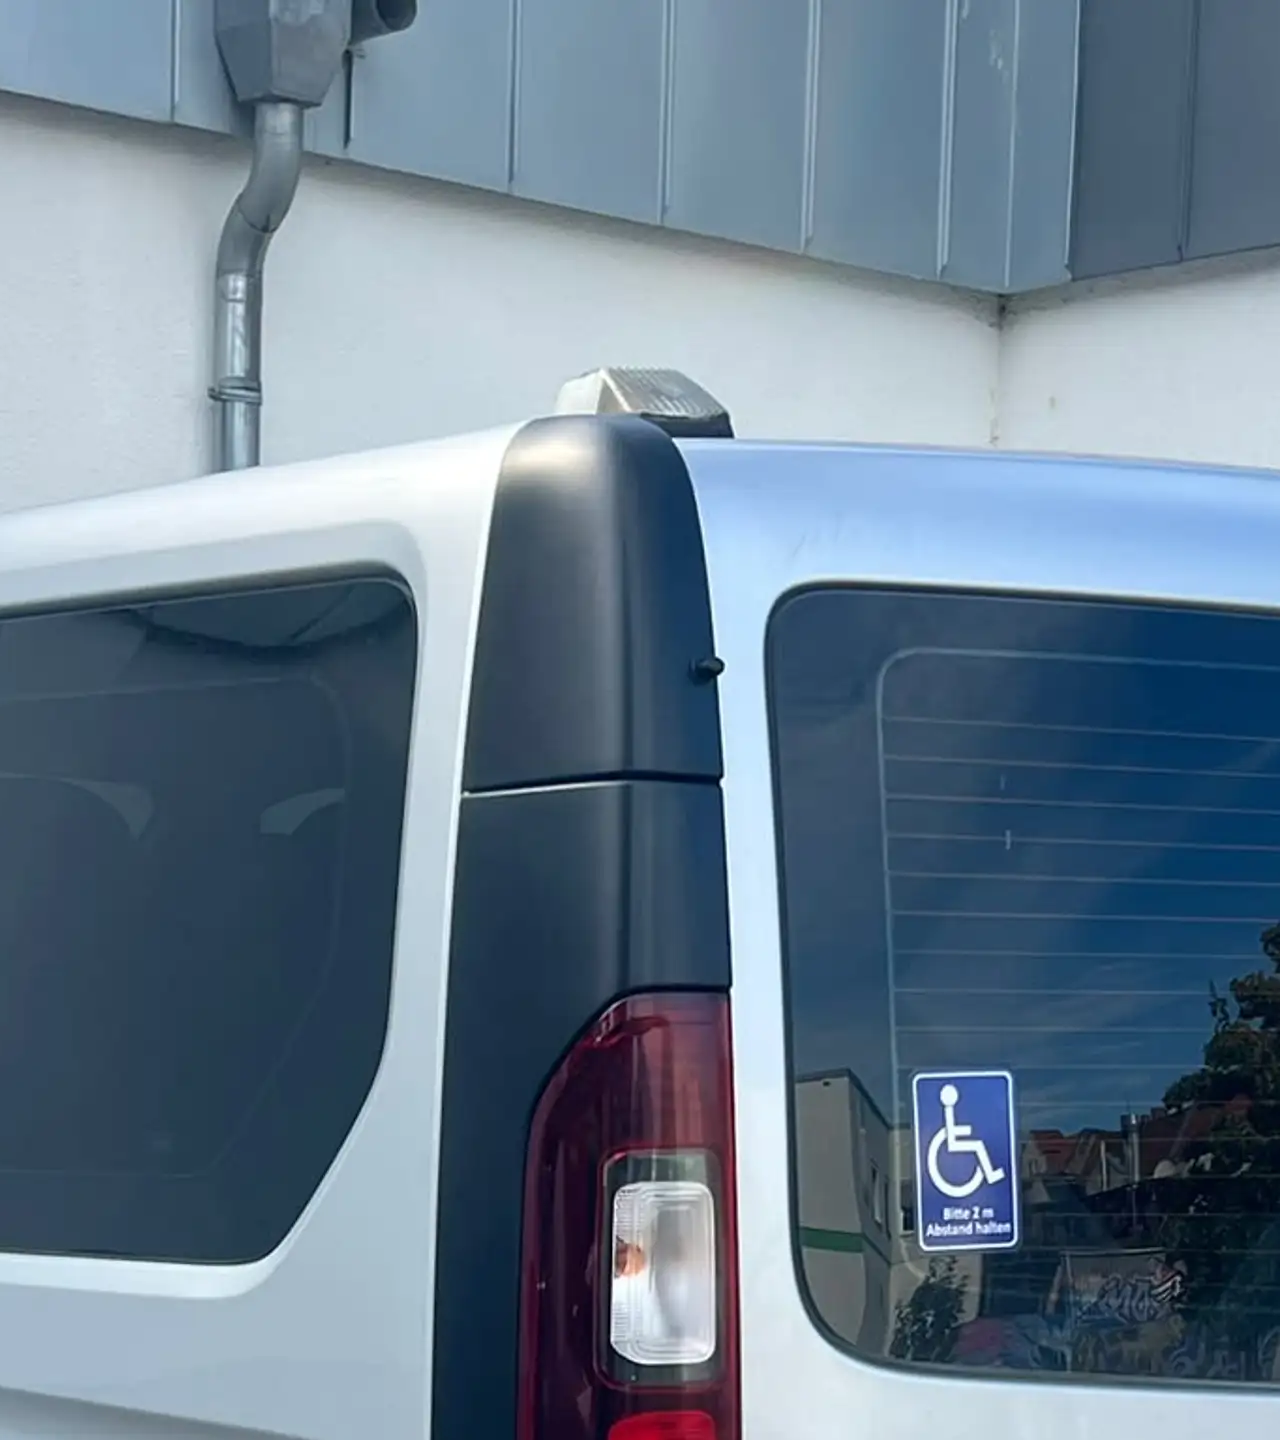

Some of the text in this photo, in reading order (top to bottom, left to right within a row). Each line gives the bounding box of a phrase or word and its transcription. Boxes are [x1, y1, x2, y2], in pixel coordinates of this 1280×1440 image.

[943, 1206, 994, 1220] Bitte 2 m
[926, 1220, 1011, 1237] Abstand halten
